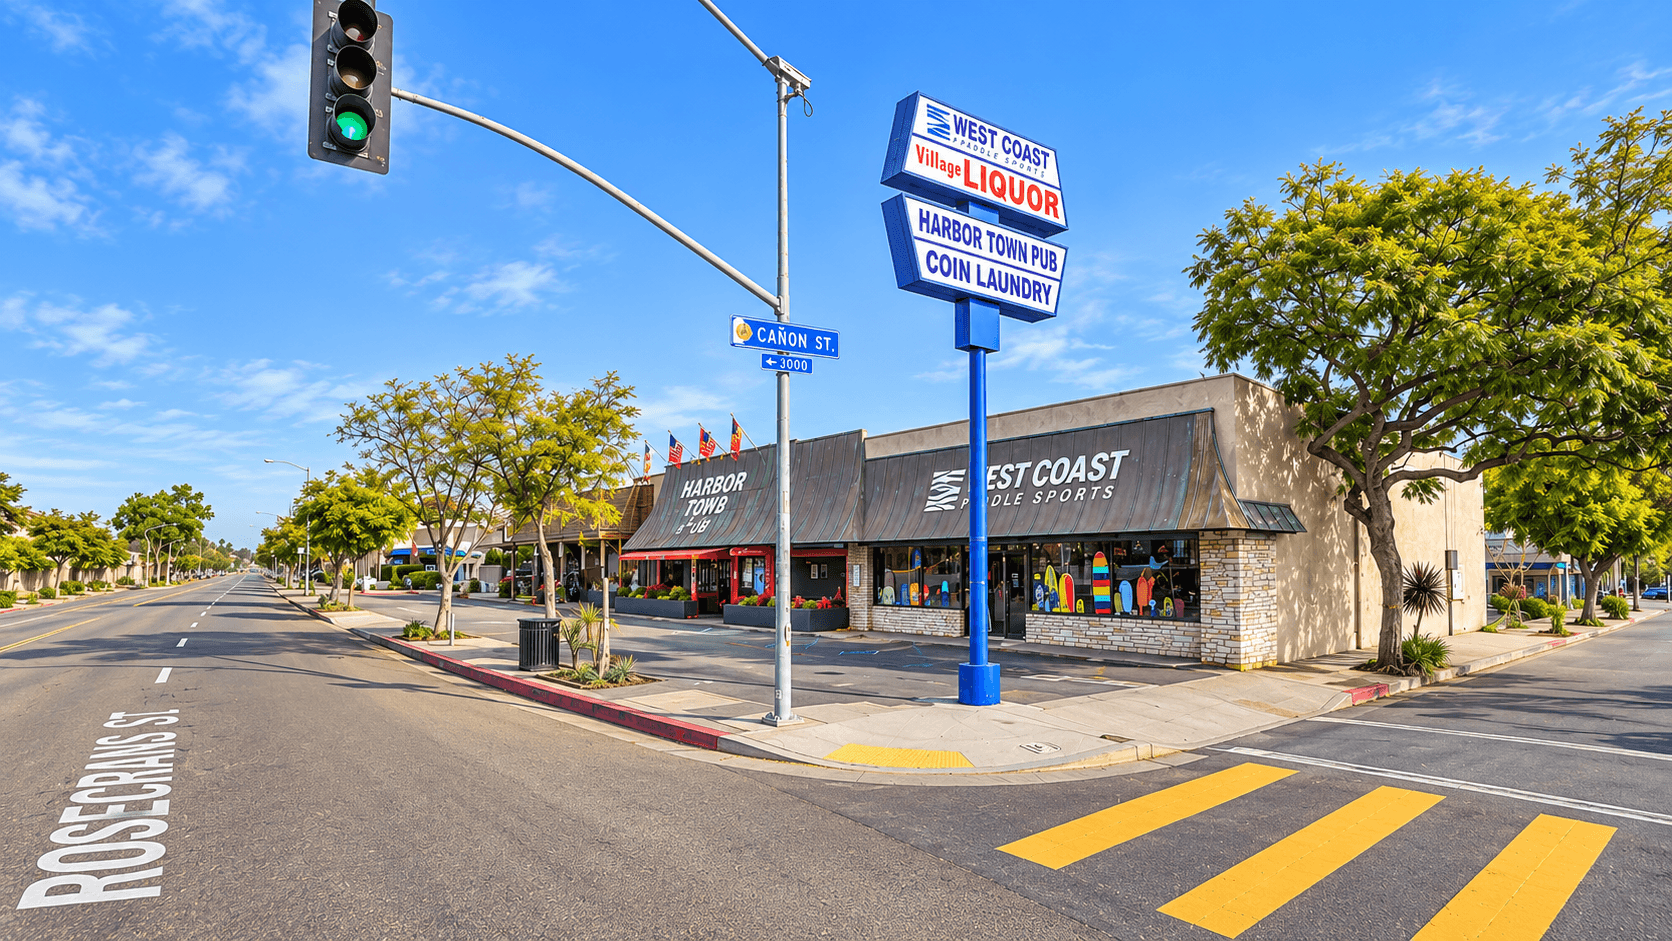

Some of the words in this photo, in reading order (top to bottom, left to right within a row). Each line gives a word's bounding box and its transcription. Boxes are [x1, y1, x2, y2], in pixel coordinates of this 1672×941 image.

[953, 114, 997, 148] WEST
[1002, 135, 1050, 169] COAST
[916, 144, 961, 179] Village
[964, 158, 1060, 219] LIQUOR
[918, 208, 983, 250] HARBOR
[986, 230, 1028, 264] TOWN
[1031, 244, 1058, 272] PUB
[925, 250, 971, 283] COIN
[976, 264, 1052, 306] LAUNDRY
[757, 326, 807, 349] CAÑON
[815, 336, 835, 352] ST.
[780, 358, 808, 371] 3000
[680, 471, 747, 499] HARBOR
[968, 461, 1032, 491] EST
[1032, 449, 1131, 487] COAST
[960, 492, 1024, 510] PDLE
[1032, 485, 1114, 504] SPORTS
[16, 731, 178, 910] ROSECRANS
